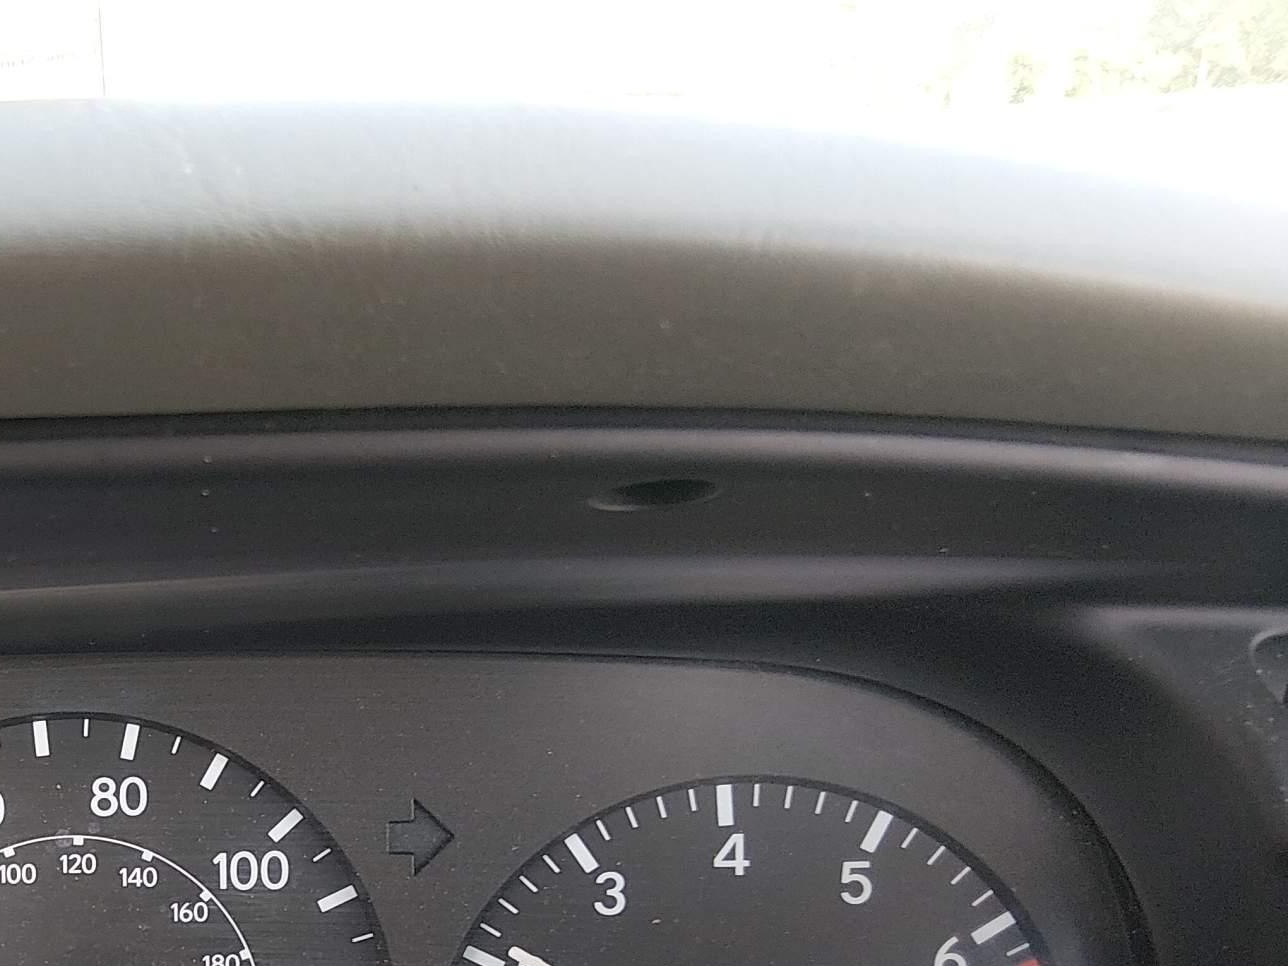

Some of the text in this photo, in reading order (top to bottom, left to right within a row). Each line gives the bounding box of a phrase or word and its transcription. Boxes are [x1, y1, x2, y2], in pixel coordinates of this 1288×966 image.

[91, 777, 147, 817] 80
[60, 854, 97, 874] 120
[213, 851, 289, 890] 100
[713, 833, 750, 876] 4
[119, 867, 158, 888] 140
[594, 873, 626, 916] 3
[840, 861, 873, 905] 5
[171, 902, 209, 923] 160
